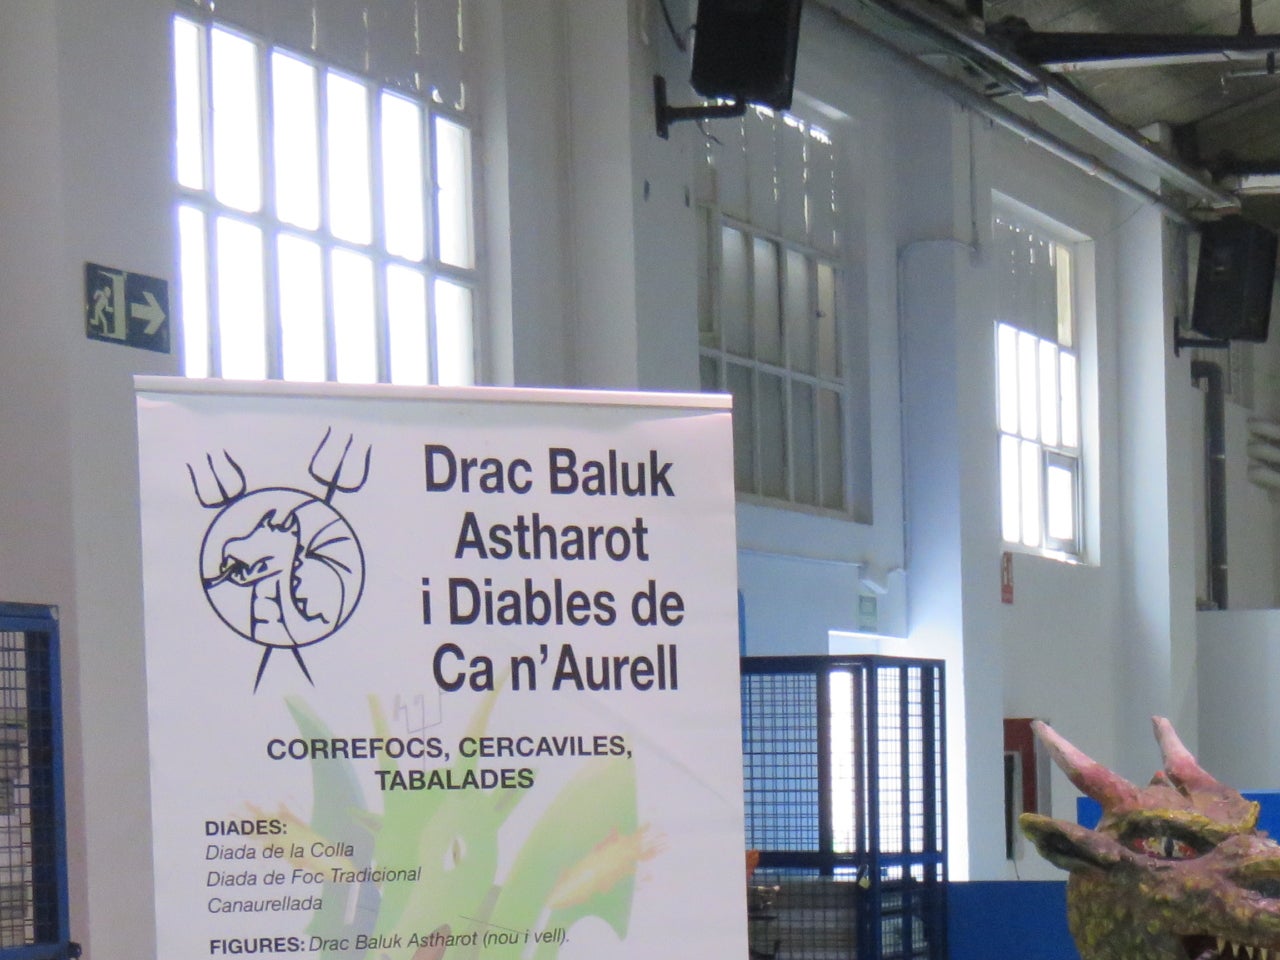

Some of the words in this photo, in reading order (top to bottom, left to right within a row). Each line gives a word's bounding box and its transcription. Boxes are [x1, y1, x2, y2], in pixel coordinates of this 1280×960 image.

[424, 444, 533, 495] Drac
[549, 448, 676, 497] Baluk
[454, 512, 650, 562] Astharot
[422, 577, 432, 625] i
[448, 578, 617, 627] Diables
[631, 579, 685, 627] de
[432, 643, 496, 693] Ca
[266, 737, 450, 762] CORREFOCS,
[458, 735, 632, 760] CERCAVILES,
[374, 769, 535, 791] TABALADES
[205, 819, 288, 837] DIADES:
[205, 844, 257, 861] Diada
[262, 843, 285, 859] de
[290, 843, 305, 859] la
[311, 842, 354, 858] Colla
[206, 870, 257, 887] Diada
[263, 870, 286, 886] de
[291, 868, 325, 885] Foc
[331, 866, 422, 883] Tradicional
[208, 895, 323, 914] Canaurellada
[210, 936, 306, 955] FIGURES:
[309, 936, 350, 952] Drac
[355, 934, 402, 950] Baluk
[407, 930, 479, 949] Astharot
[483, 929, 520, 949] (nou
[534, 928, 570, 946] vell).
